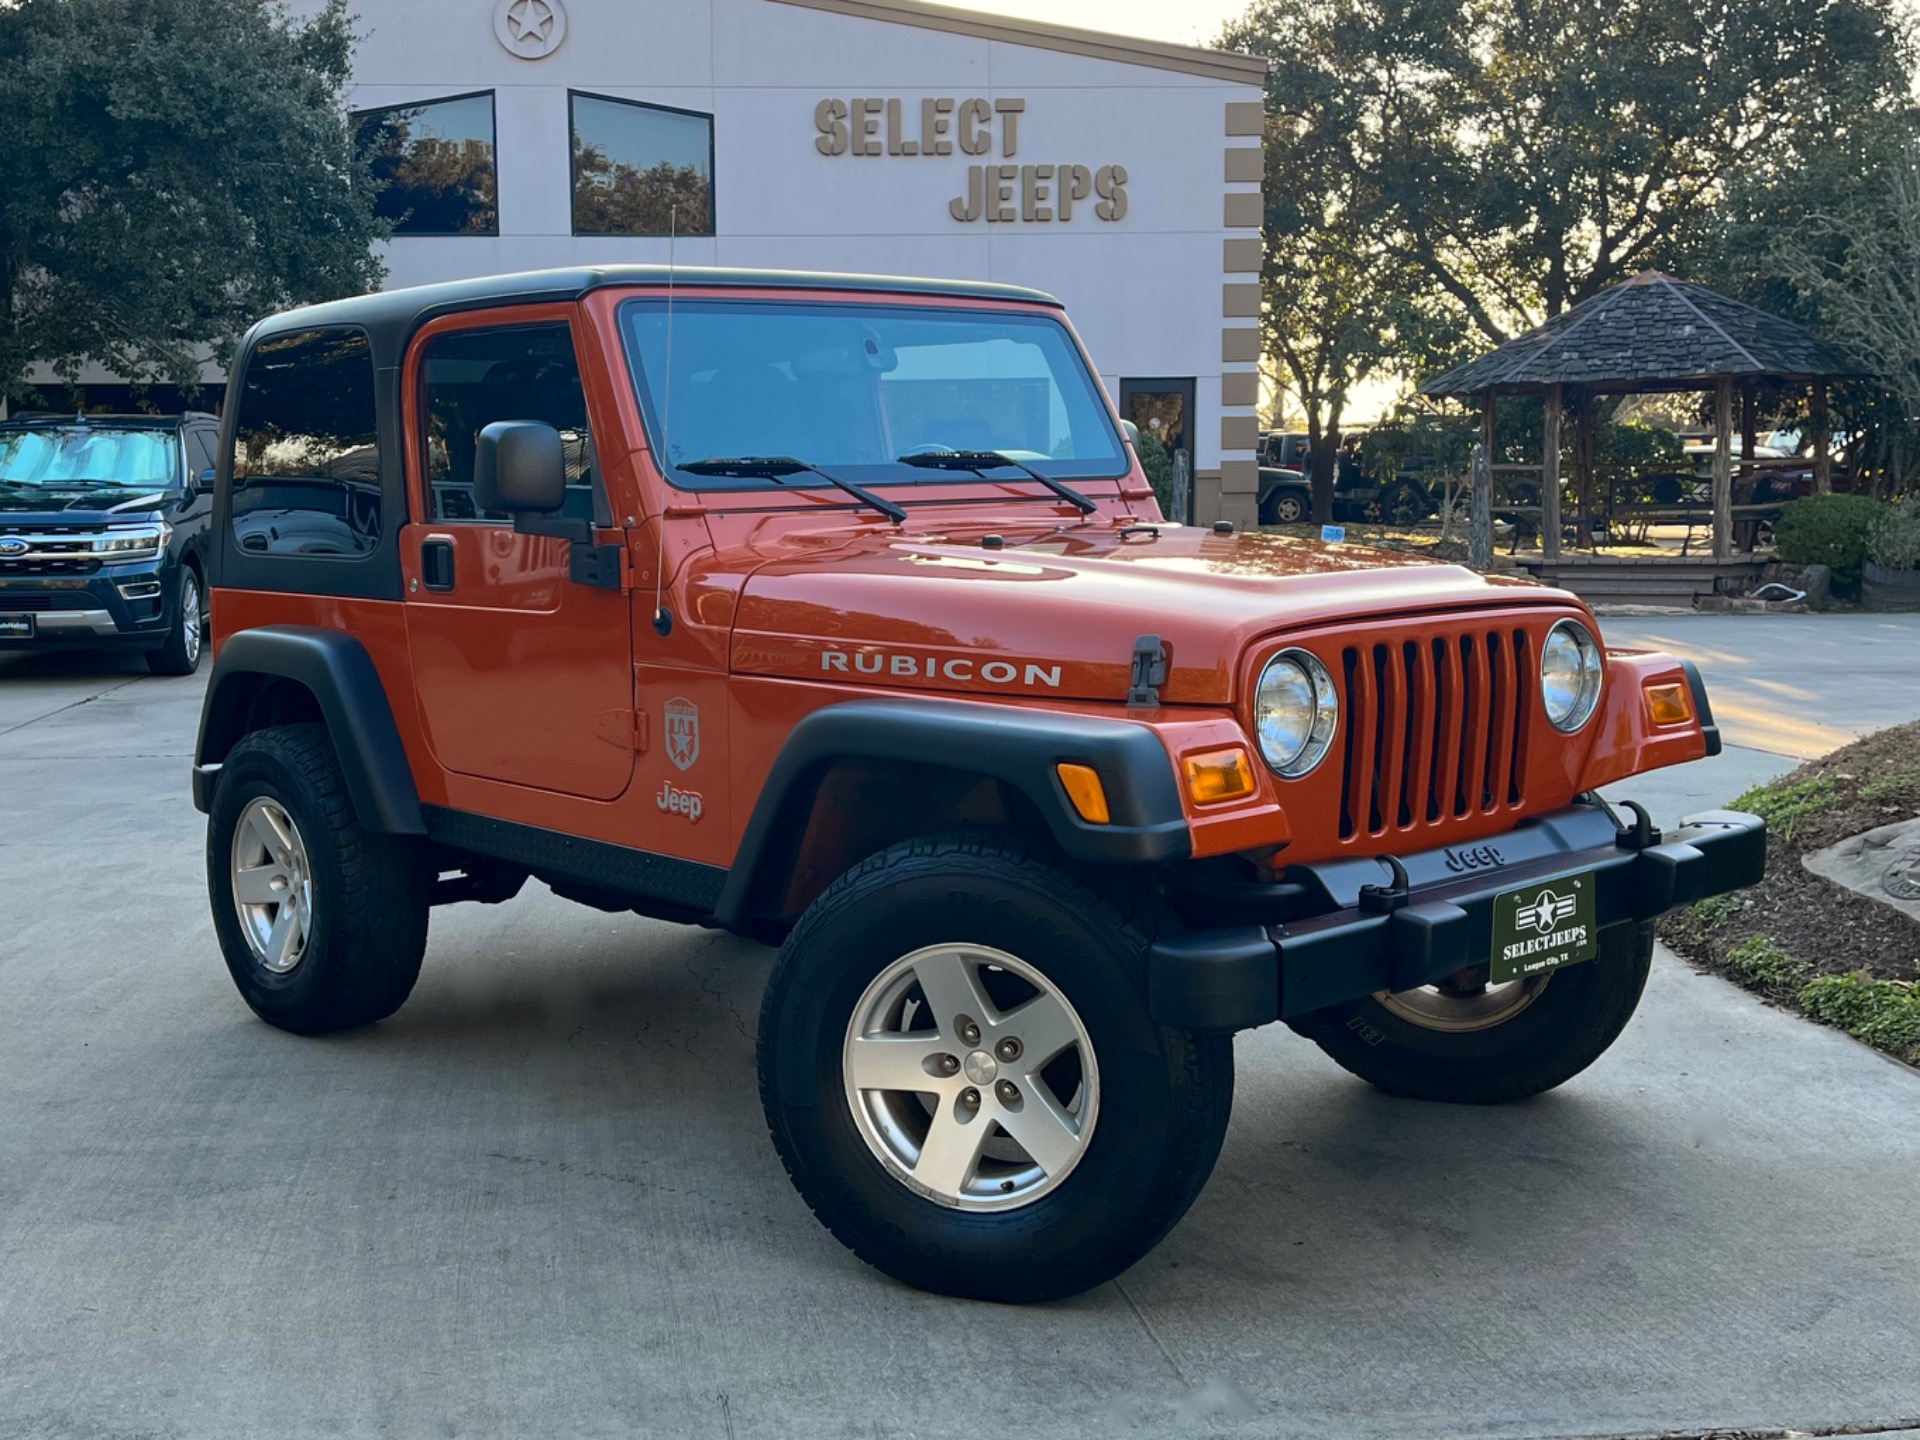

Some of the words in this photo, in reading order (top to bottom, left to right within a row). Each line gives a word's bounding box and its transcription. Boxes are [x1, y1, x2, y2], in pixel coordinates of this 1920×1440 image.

[814, 97, 1025, 158] SELECT
[949, 164, 1128, 221] JEEPS
[821, 651, 1061, 687] RUBICON
[656, 780, 703, 822] Jeep
[1444, 845, 1505, 872] Jeep
[1503, 925, 1587, 960] SELECTJEEPS
[1524, 961, 1546, 971] League
[1560, 952, 1569, 961] TX
